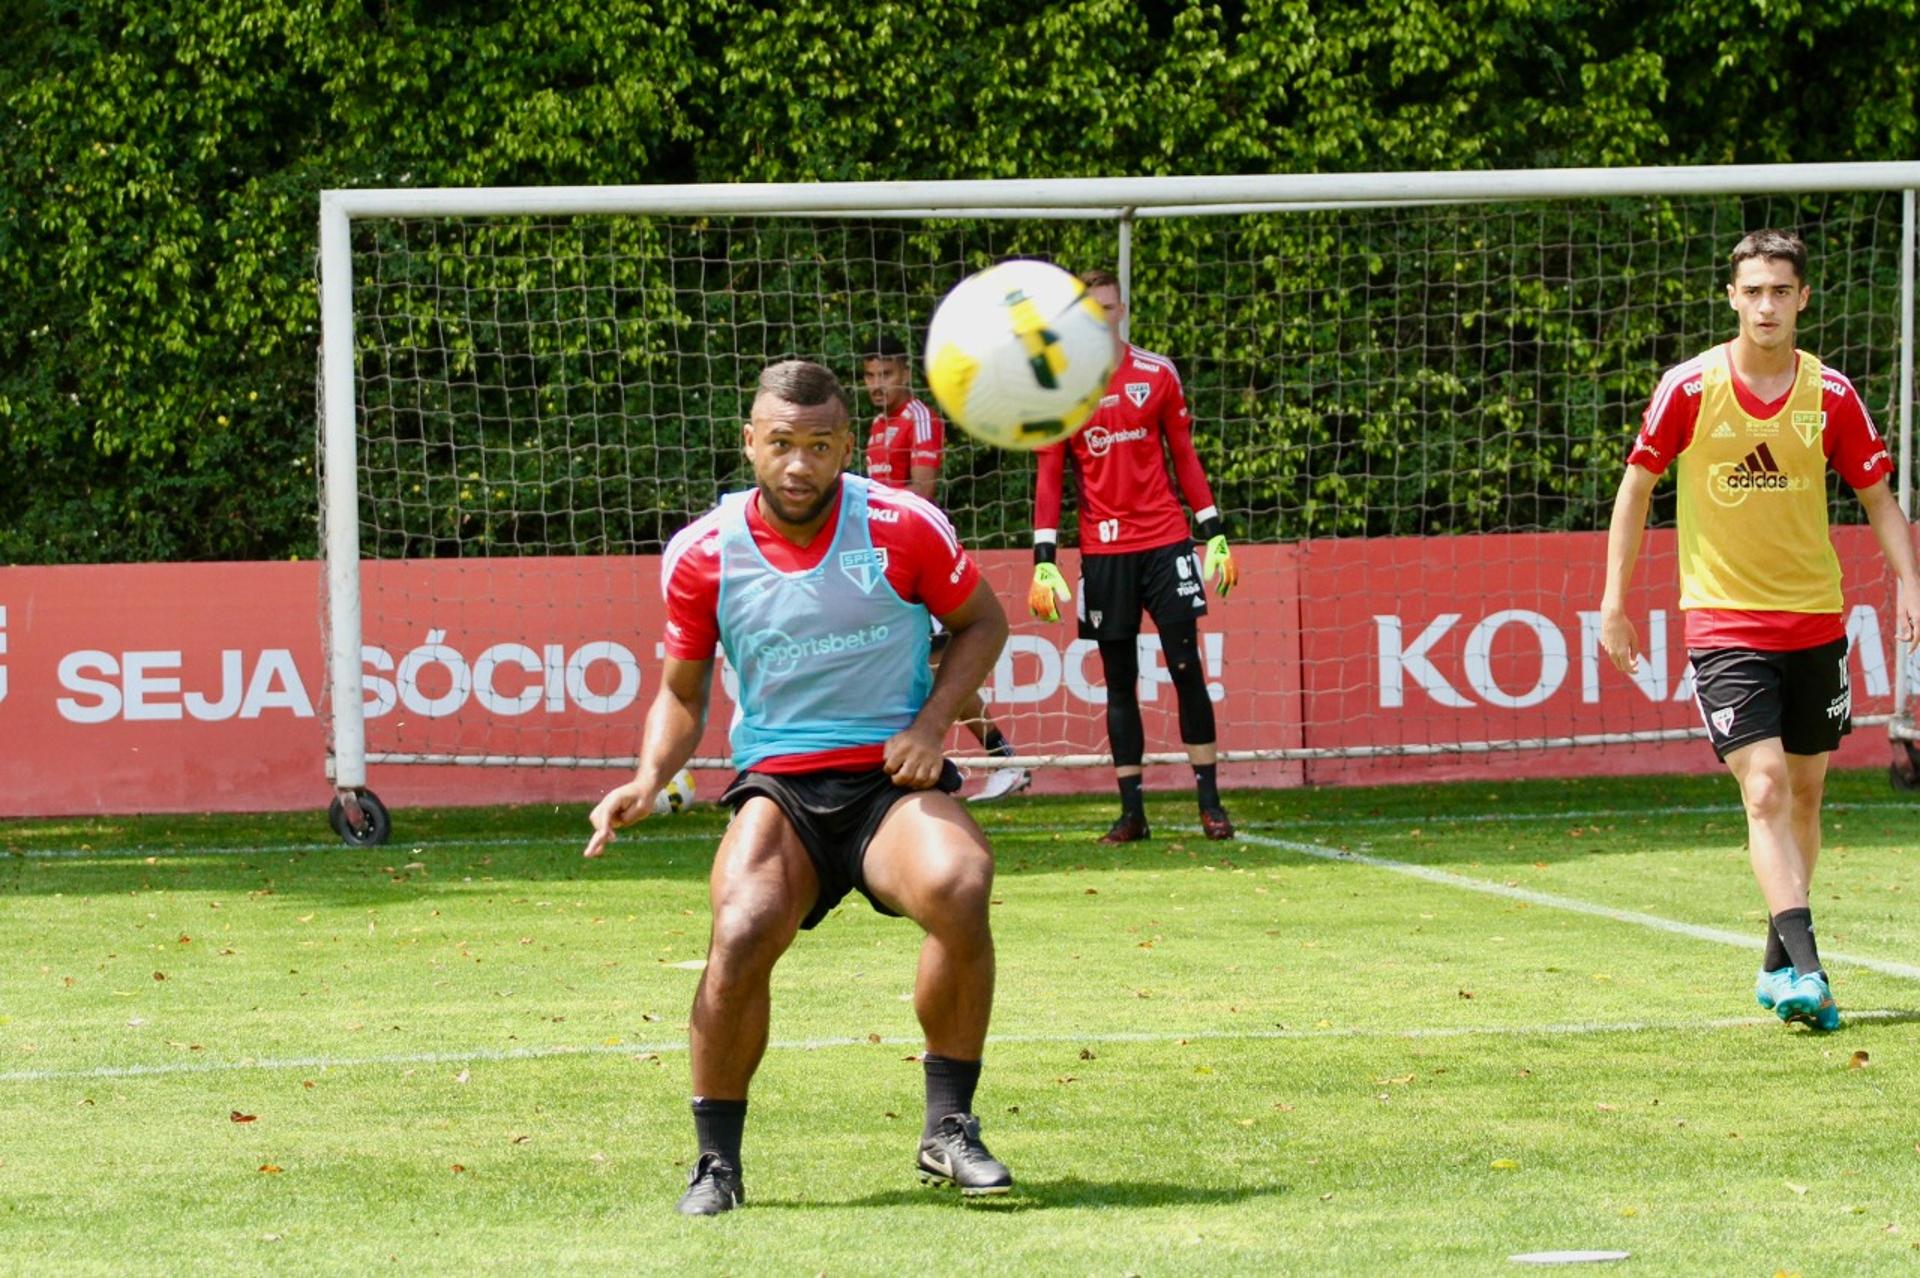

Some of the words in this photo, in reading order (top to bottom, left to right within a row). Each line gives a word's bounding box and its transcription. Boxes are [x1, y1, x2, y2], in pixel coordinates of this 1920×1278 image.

[1727, 471, 1788, 489] adidas
[761, 625, 889, 667] Sportsbet.io
[56, 648, 316, 724] SEJA
[360, 629, 641, 719] SÓCIO
